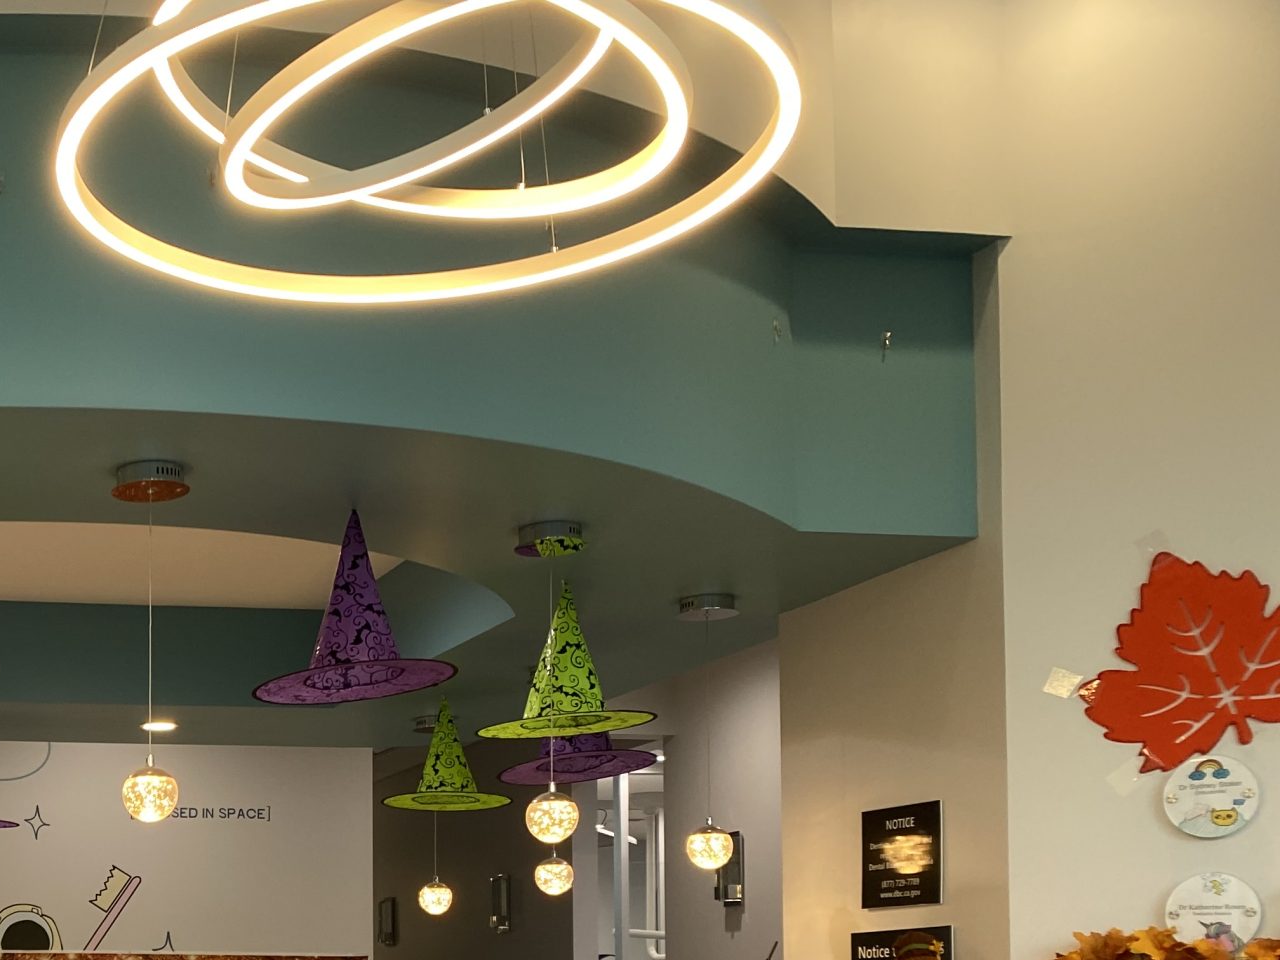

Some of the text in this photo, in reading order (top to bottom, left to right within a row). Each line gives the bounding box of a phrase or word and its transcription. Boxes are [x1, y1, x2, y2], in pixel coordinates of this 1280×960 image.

[202, 807, 214, 818] IN
[218, 805, 271, 821] SPACE]
[885, 817, 915, 830] NOTICE
[857, 945, 890, 959] Notice
